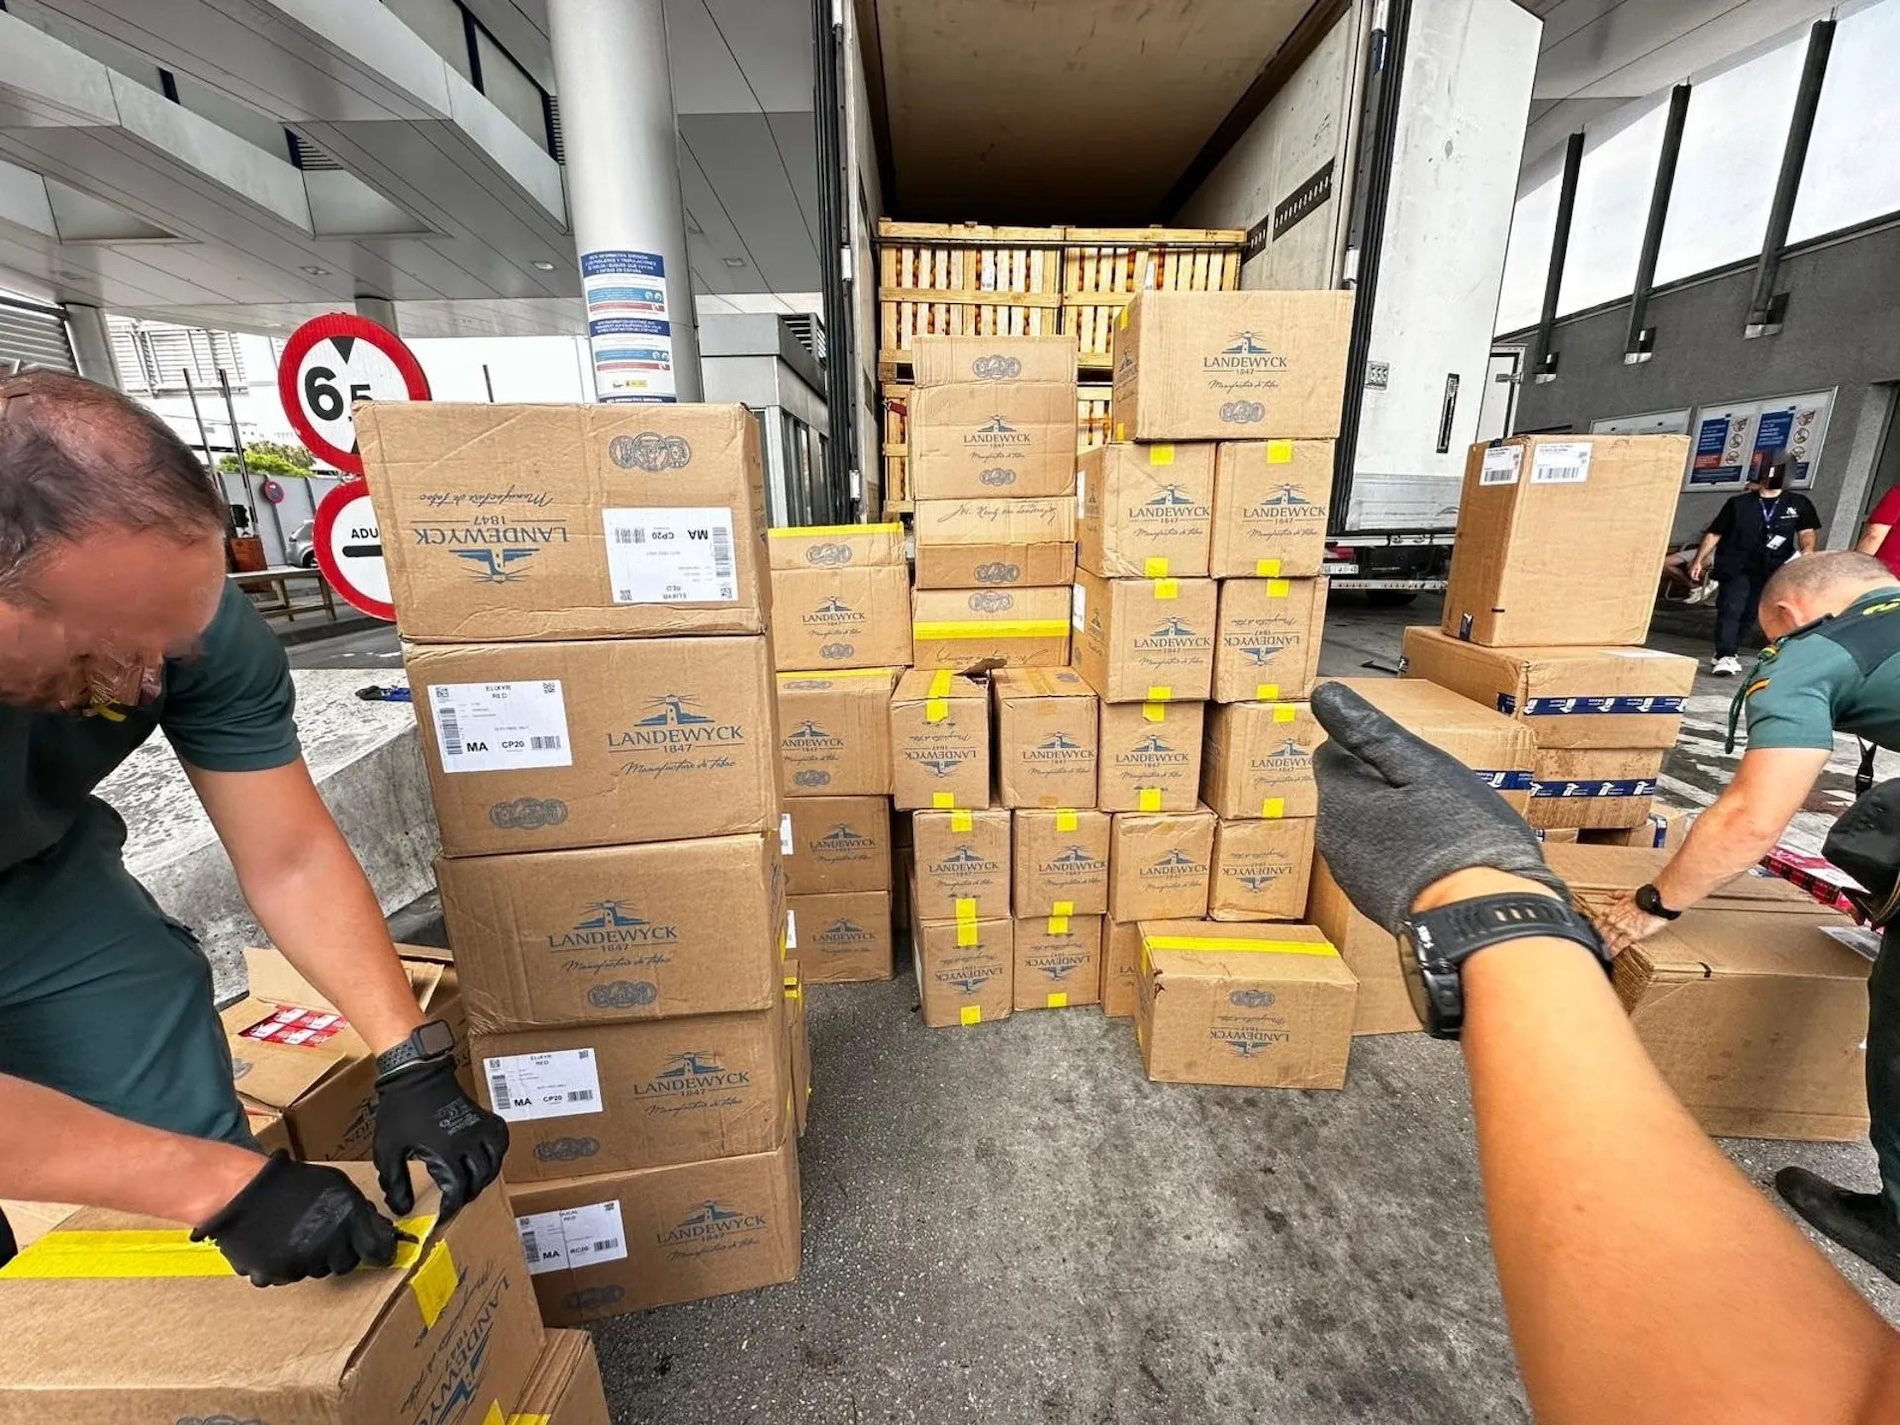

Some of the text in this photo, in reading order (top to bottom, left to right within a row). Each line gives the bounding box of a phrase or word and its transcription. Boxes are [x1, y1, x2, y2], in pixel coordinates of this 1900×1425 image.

[1203, 356, 1287, 368] LANDEWYCK
[963, 433, 1031, 444] LANDEWYCK
[1128, 506, 1210, 518] LANDEWYCK
[1243, 506, 1326, 518] LANDEWYCK
[473, 515, 506, 526] 1847
[351, 527, 379, 539] ADU
[413, 526, 569, 545] LANDEWYCK
[651, 531, 674, 540] CP20
[688, 529, 708, 540] MA
[802, 612, 865, 622] LANDEWYCK
[1134, 637, 1210, 648] LANDEWYCK
[1224, 636, 1300, 647] LANDEWYCK
[608, 725, 744, 747] LANDEWYCK
[466, 740, 524, 752] MA CP20
[781, 738, 844, 748] ANDEWYCK
[664, 744, 692, 754] 1847
[905, 750, 977, 760] LANDEWYCK
[1022, 750, 1095, 760] LANDEWYCK
[1116, 753, 1188, 764] LANDEWYCK
[810, 838, 875, 848] LANDEWYCK
[929, 862, 998, 872] LANDEWYCK
[1038, 860, 1106, 872] LANDEWYCK
[1140, 865, 1208, 876] LANDEWYCK
[1222, 866, 1292, 875] LANDEWYCK
[548, 926, 678, 949] LANDEWYCK
[812, 931, 876, 942] LANDEWYCK
[1024, 956, 1090, 967] LANDEWYCK
[935, 967, 1002, 982] LANDEWYCK
[1210, 1031, 1290, 1042] LANDEWYCK
[634, 1071, 750, 1096] LANDEWYCK
[514, 1098, 532, 1107] MA
[656, 1214, 766, 1244] LANDEWYCK
[542, 1250, 560, 1260] MA
